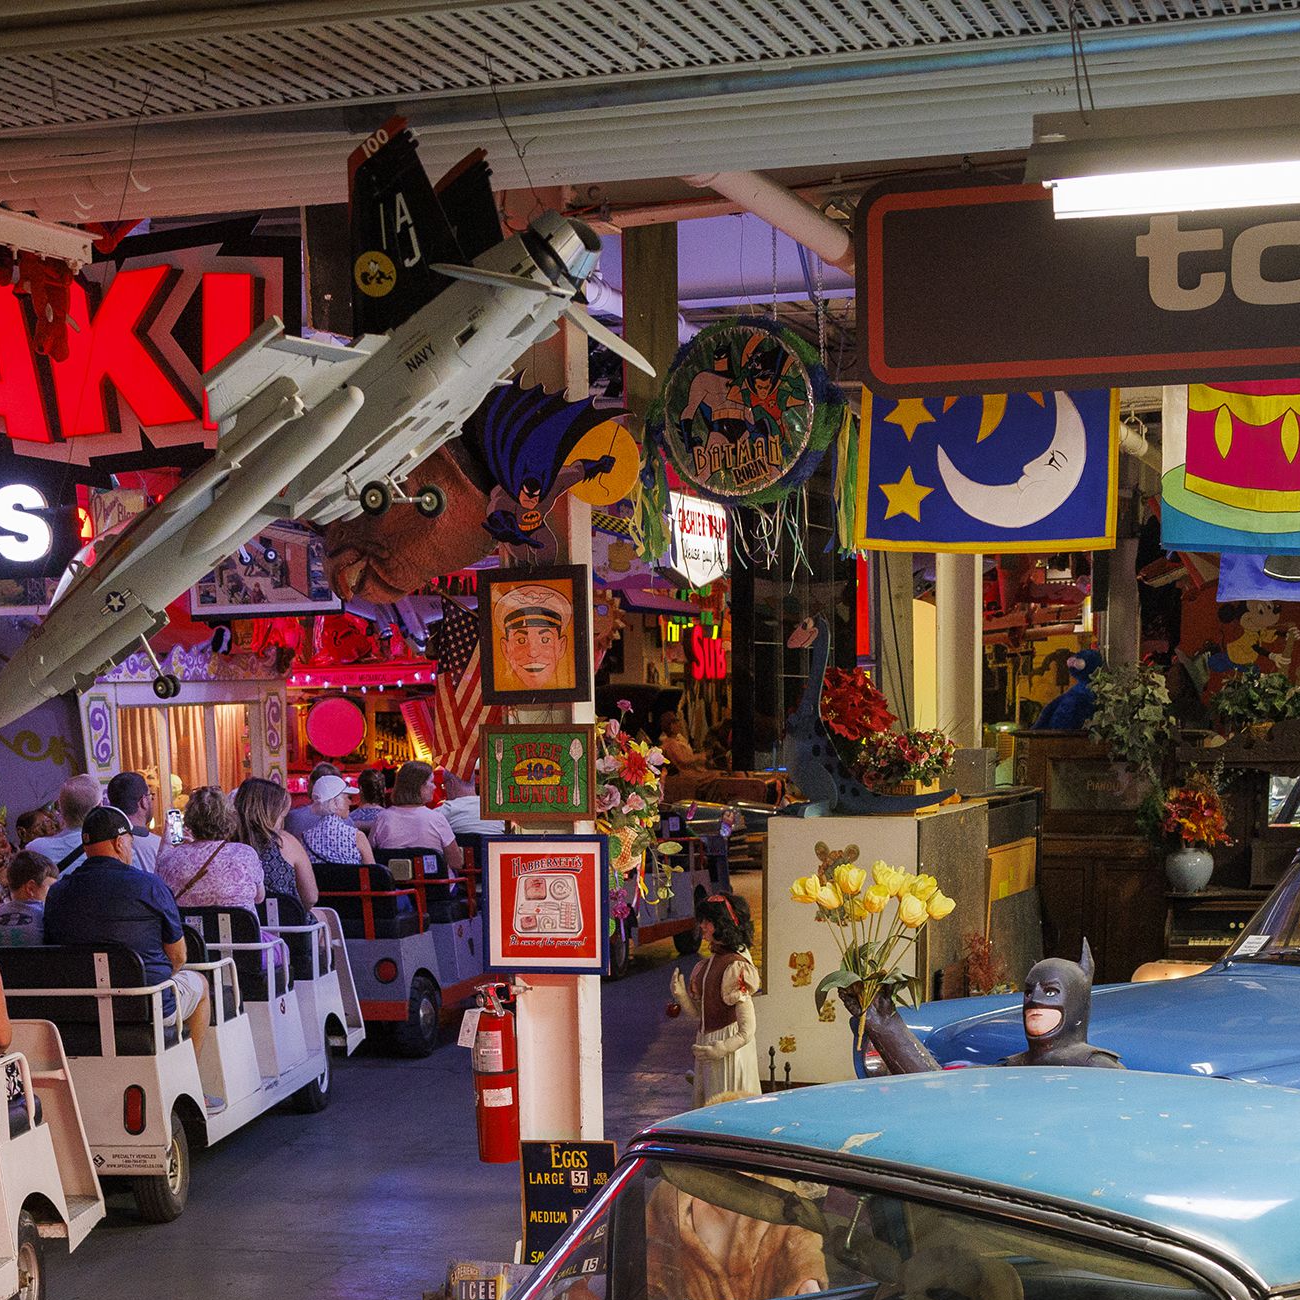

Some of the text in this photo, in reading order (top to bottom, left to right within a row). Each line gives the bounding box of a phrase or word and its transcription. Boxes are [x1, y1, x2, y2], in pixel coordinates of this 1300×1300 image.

[362, 128, 390, 158] 100
[405, 342, 436, 373] NAVY
[693, 434, 783, 478] BATMAN
[732, 457, 769, 487] ROBIN
[513, 741, 562, 763] FREE
[508, 785, 569, 804] LUNCH
[529, 1171, 586, 1185] LARGE 57
[529, 1210, 568, 1224] MEDIUM
[586, 1258, 598, 1272] 15
[461, 1281, 496, 1300] ICEE
